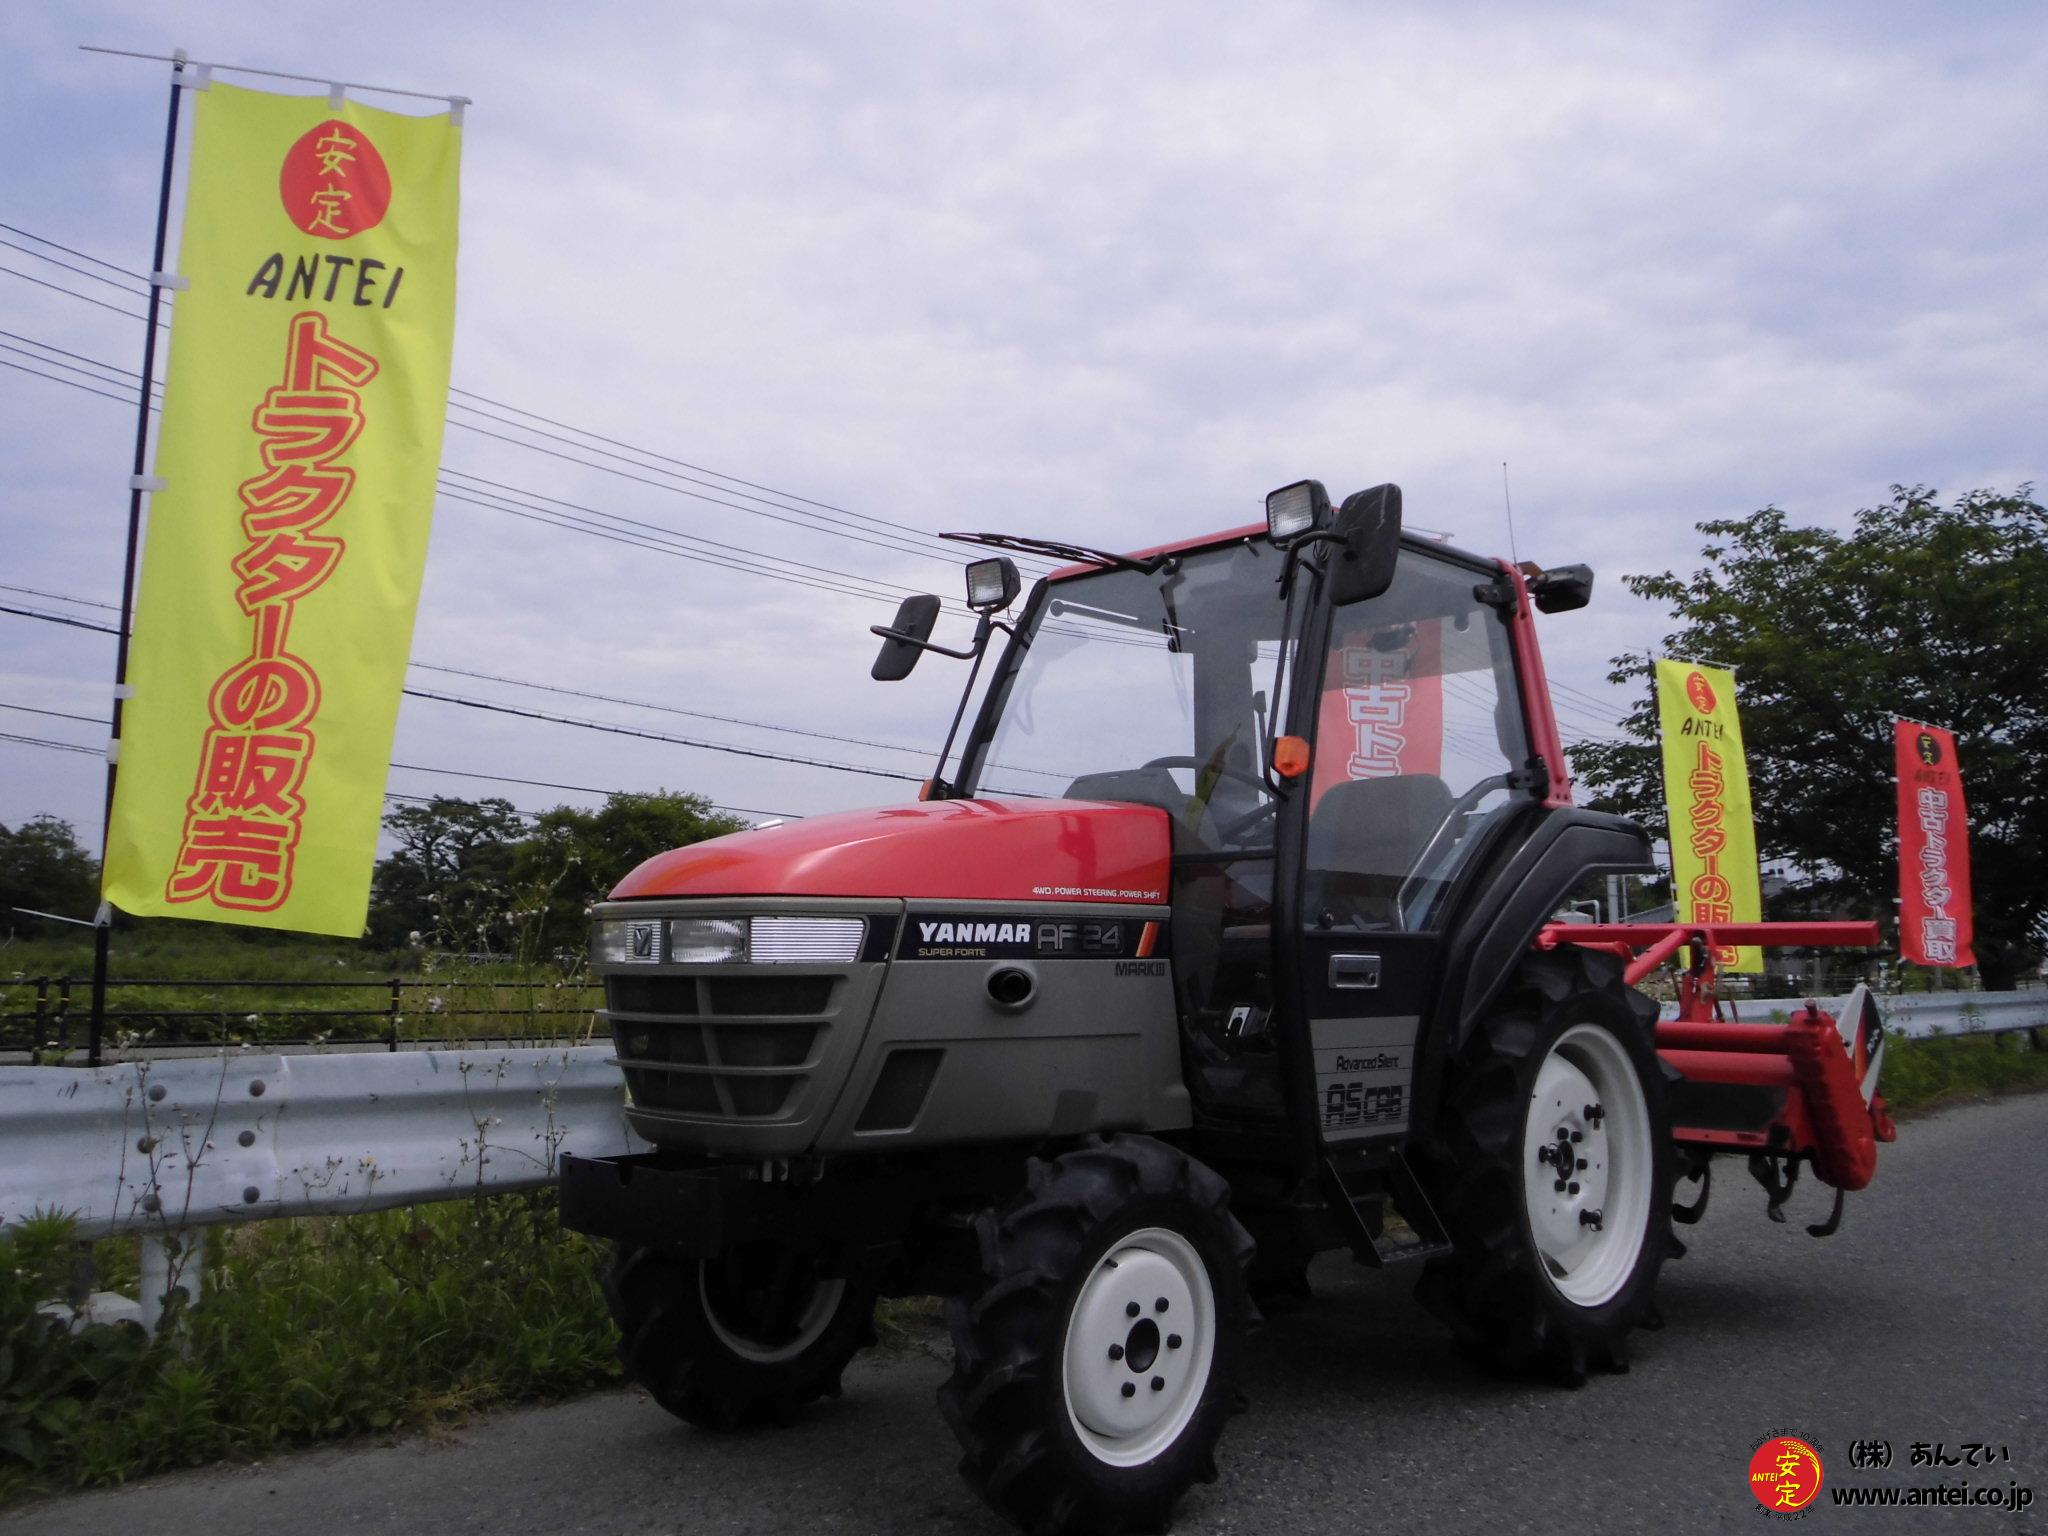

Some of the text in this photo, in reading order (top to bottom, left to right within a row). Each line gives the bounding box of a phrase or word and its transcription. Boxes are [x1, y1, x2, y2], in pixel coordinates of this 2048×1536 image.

[308, 128, 356, 234] 安定
[246, 252, 404, 309] ANTEI
[165, 311, 380, 913] トラクターの販売
[1055, 887, 1082, 896] POWER
[918, 947, 986, 957] SUPER FORTE
[919, 922, 1031, 943] YANMAR
